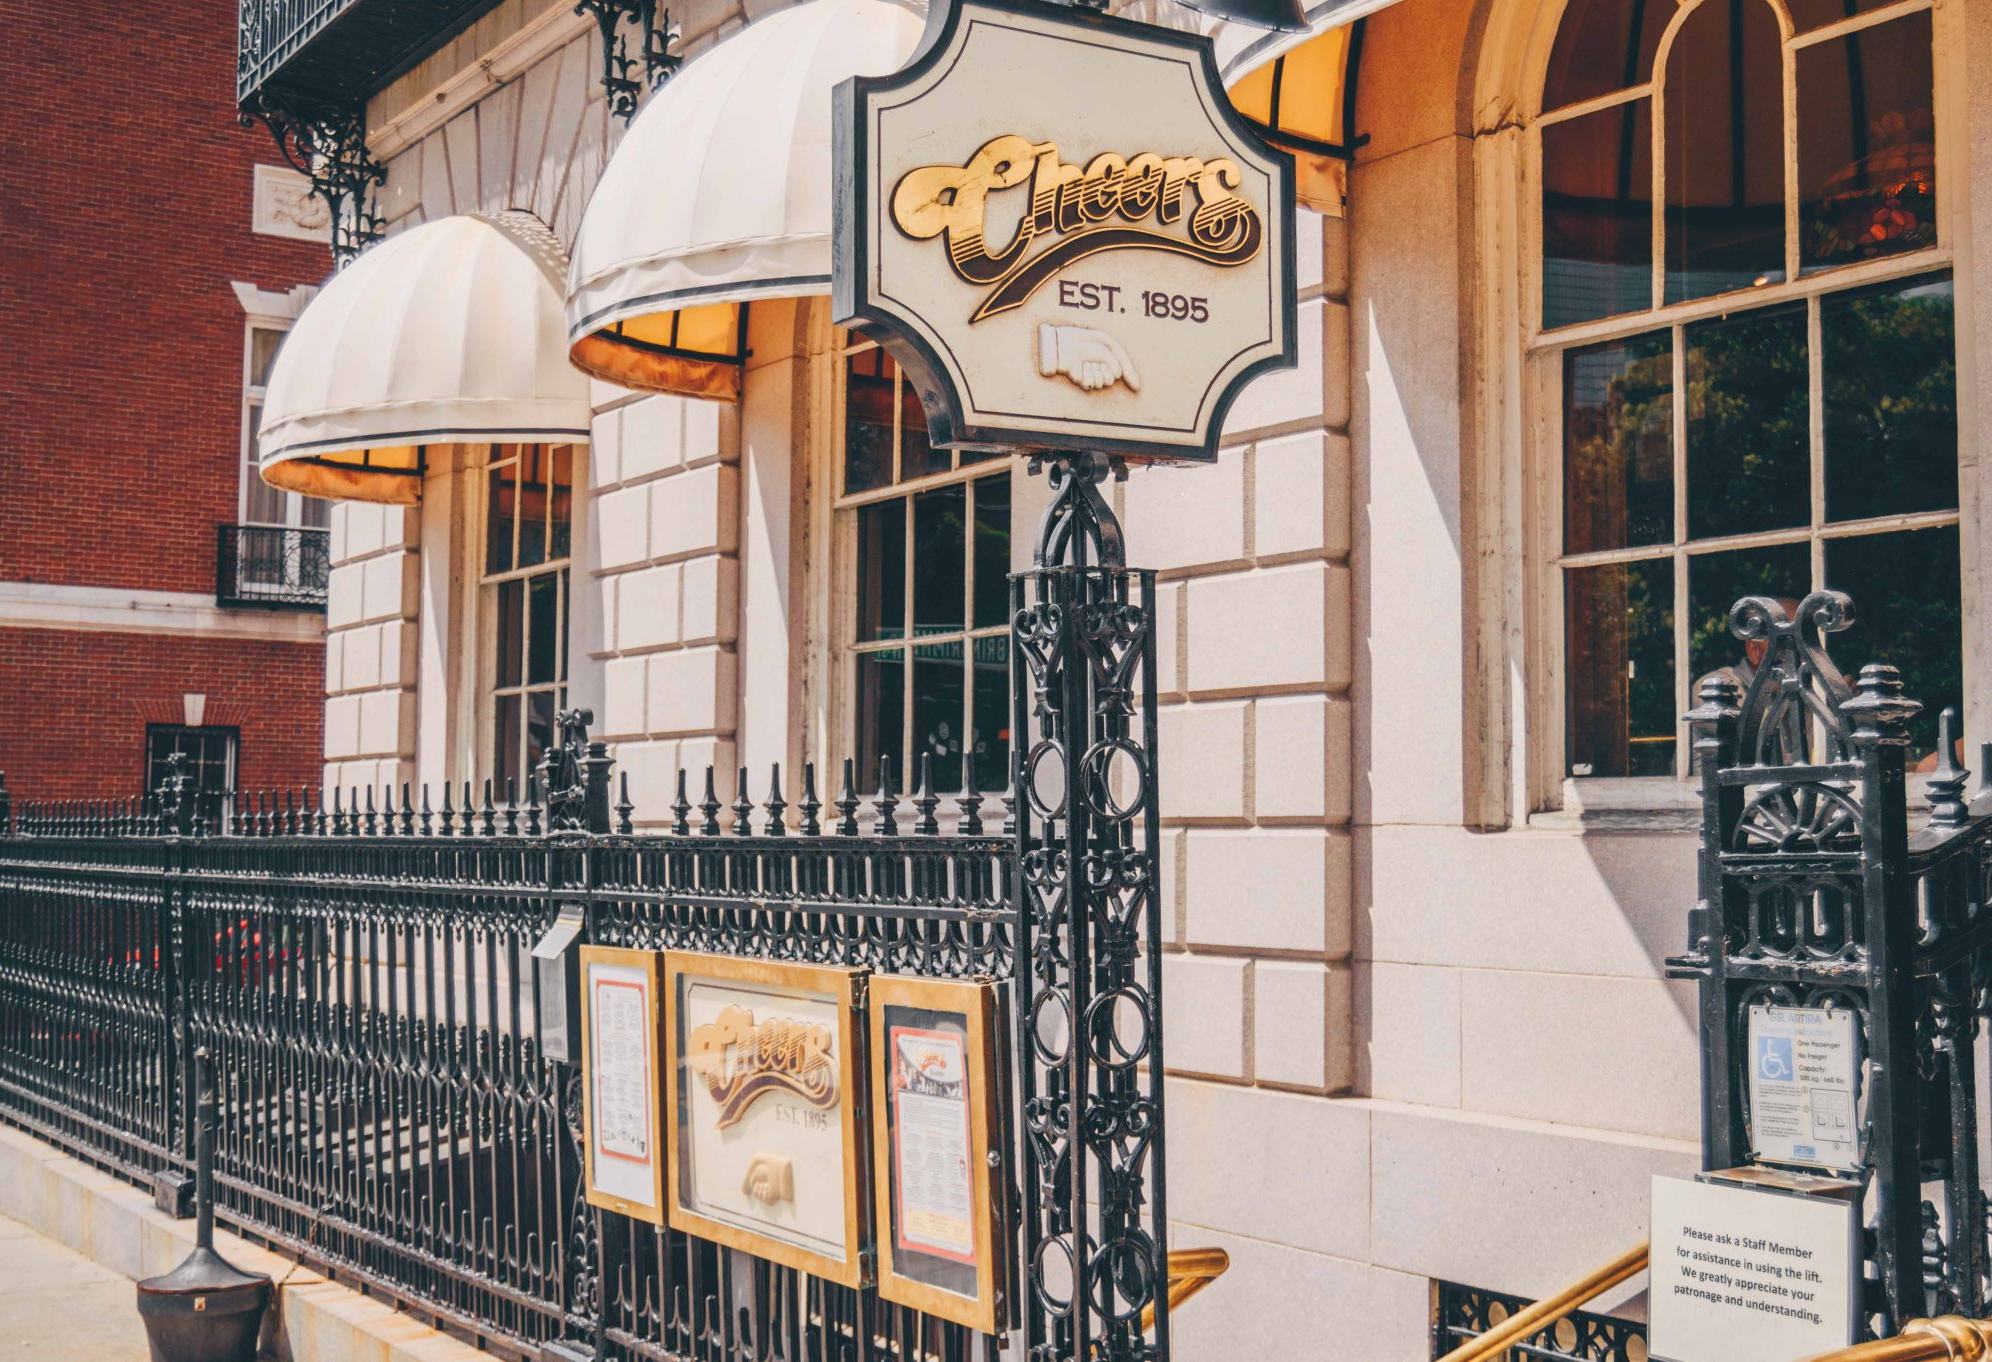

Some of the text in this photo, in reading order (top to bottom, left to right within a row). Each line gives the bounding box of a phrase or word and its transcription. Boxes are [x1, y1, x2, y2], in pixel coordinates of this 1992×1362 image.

[889, 134, 1262, 325] Cheers
[1058, 279, 1209, 324] EST. 1895
[1808, 1053, 1827, 1061] Freight
[1811, 1041, 1841, 1050] Passenger
[686, 1004, 840, 1130] Cheers
[776, 1104, 828, 1131] EST. 1895
[1683, 1226, 1813, 1260] Please ask a Staff Member
[1676, 1246, 1823, 1284] for assistance in using the lift.
[1681, 1266, 1816, 1302] We greatly appreciate your
[1674, 1284, 1823, 1325] patronage and understanding.
